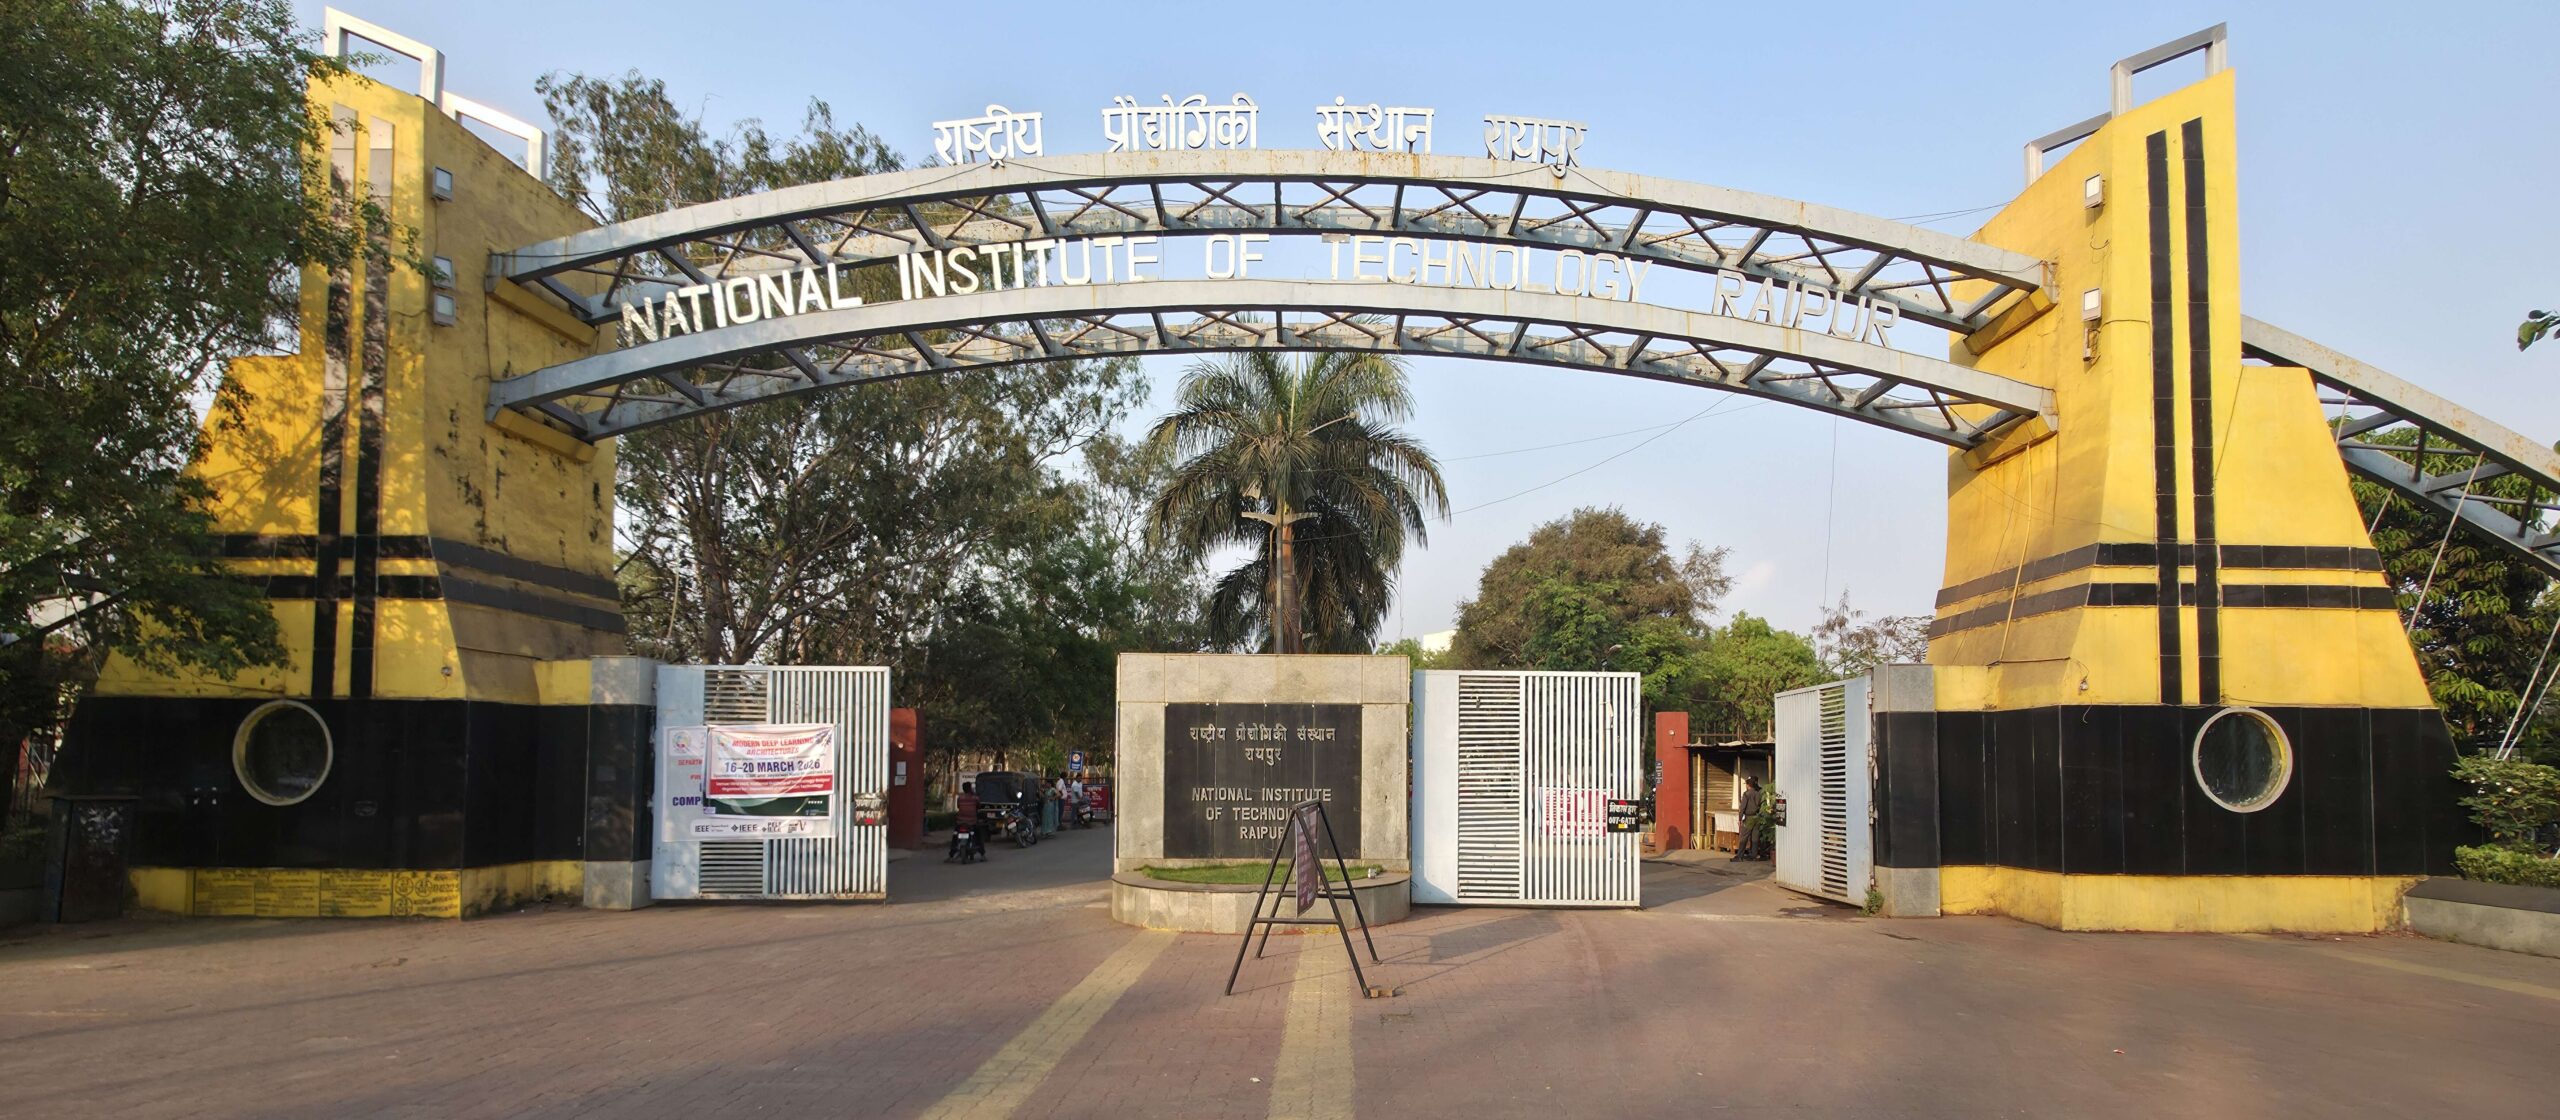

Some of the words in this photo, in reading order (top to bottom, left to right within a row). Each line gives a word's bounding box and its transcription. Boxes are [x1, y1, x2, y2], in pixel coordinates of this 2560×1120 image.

[932, 104, 1044, 168] राष्ट्रीय
[1102, 92, 1260, 153] प्रौद्योगिकी
[1316, 95, 1434, 152] संस्थान
[1484, 114, 1588, 179] रायपुर
[616, 262, 862, 348] NATIONAL
[899, 236, 1159, 300] INSTITUTE
[1204, 233, 1271, 279] OF
[1322, 232, 1654, 302] TECHNOLOGY
[1712, 268, 1901, 347] RAIPUR
[1190, 723, 1226, 743] राष्ट्रीय
[1236, 722, 1287, 742] प्रौद्योगिकी
[1297, 725, 1336, 741] संस्थान
[1245, 747, 1282, 766] रायपुर
[757, 761, 795, 773] MARCH
[672, 796, 701, 806] COMP
[1192, 787, 1252, 801] NATIONAL
[1262, 788, 1331, 801] INSTITUTE
[1206, 807, 1222, 820] OF
